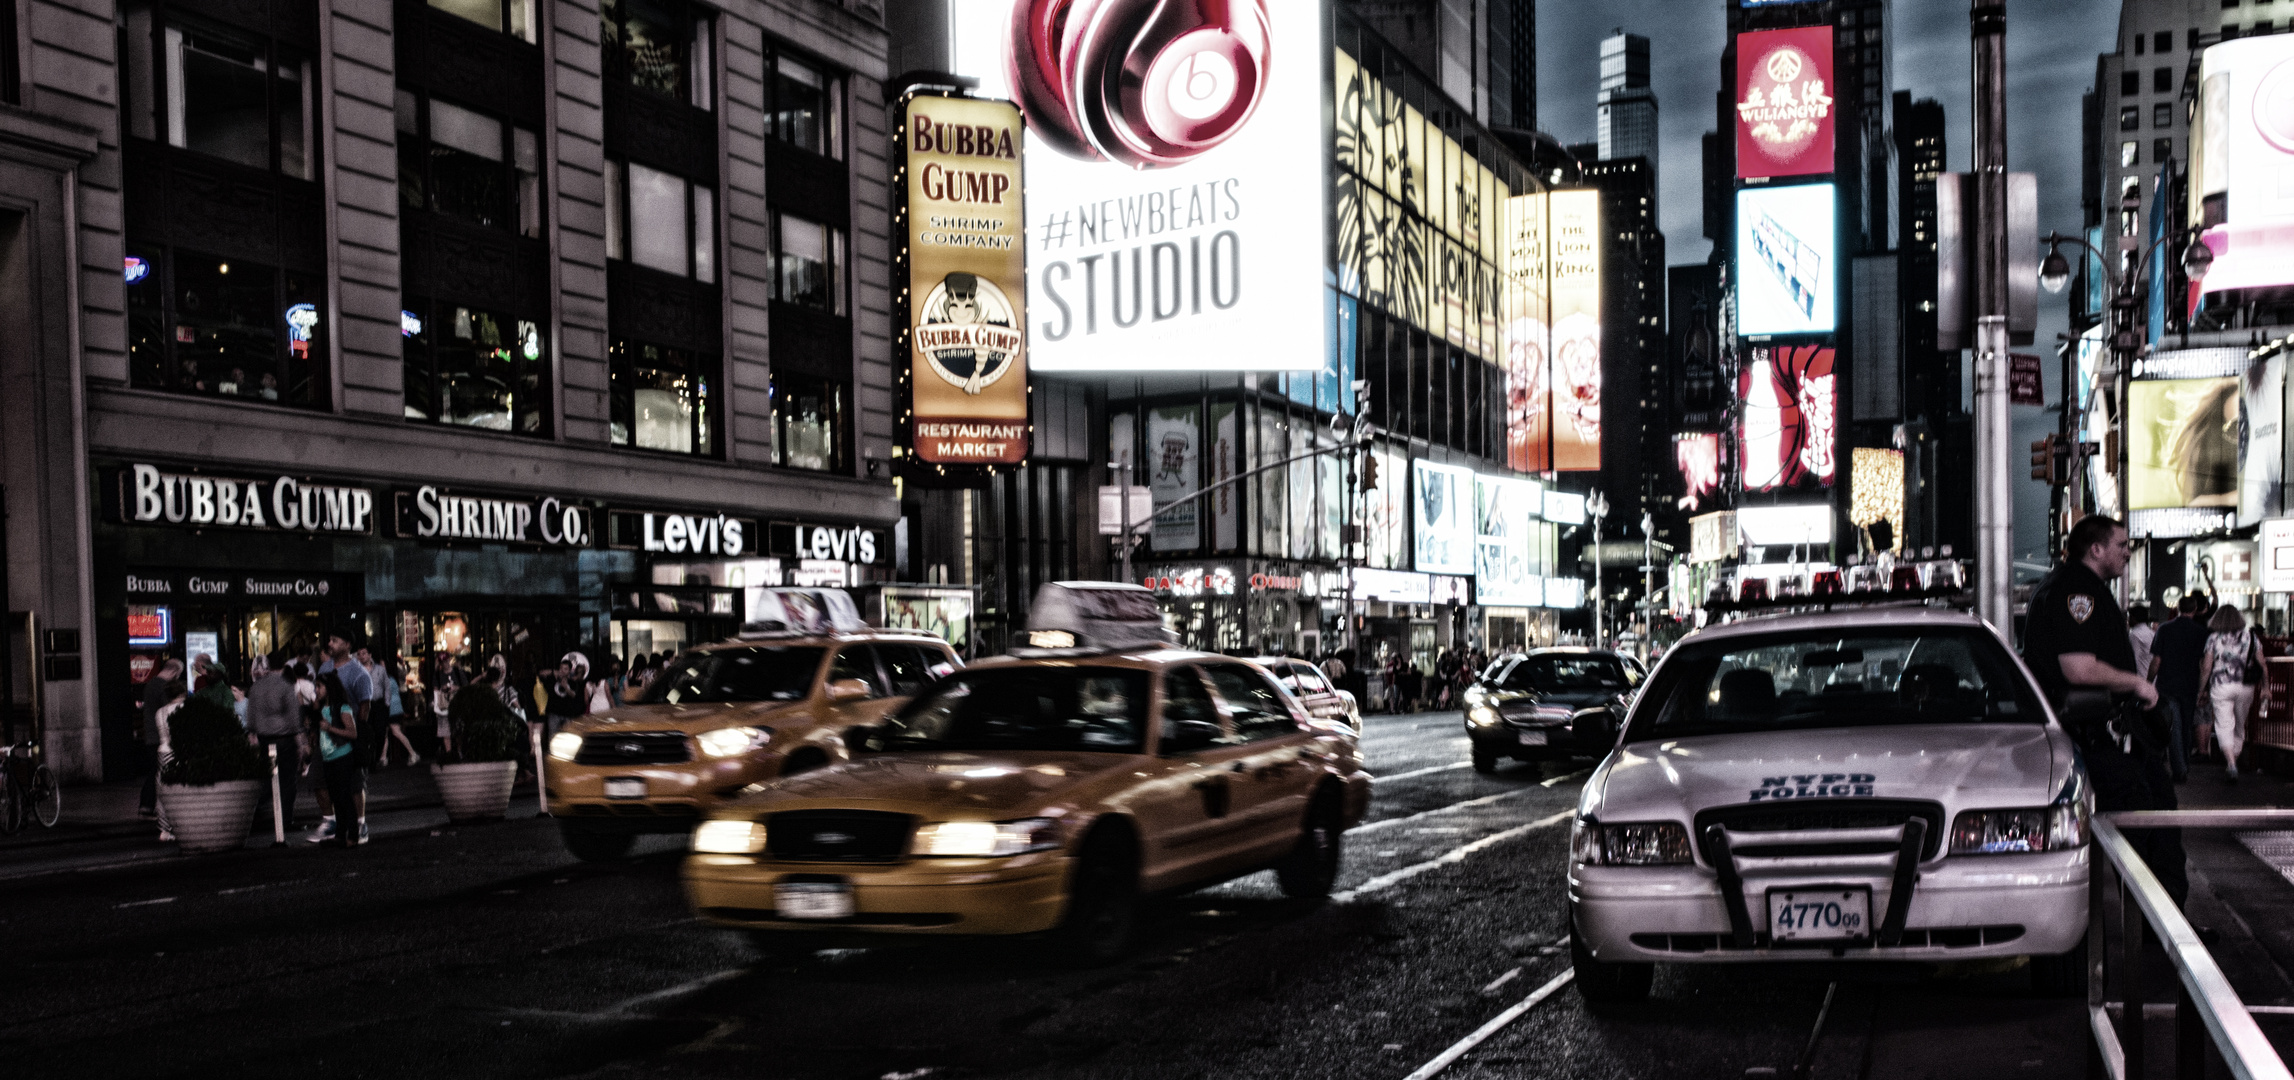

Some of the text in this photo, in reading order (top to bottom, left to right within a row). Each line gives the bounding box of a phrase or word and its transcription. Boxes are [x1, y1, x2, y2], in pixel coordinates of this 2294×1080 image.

[913, 112, 1017, 159] BUBBA
[921, 162, 1010, 205] GUMP
[1040, 177, 1241, 251] #NEWBEATS
[1455, 181, 1479, 231] THE
[929, 215, 1004, 232] SHRIMP
[1562, 227, 1585, 236] THE
[920, 231, 1014, 250] COMPANY
[1557, 240, 1591, 256] LION
[1432, 215, 1469, 307] LION
[1555, 261, 1594, 279] KING
[1041, 229, 1242, 342] STUDIO
[919, 327, 1019, 350] BUBBA GUMP
[937, 348, 974, 360] SHRIMP
[918, 423, 1025, 440] RESTAURANT
[938, 443, 1007, 458] MARKET
[133, 463, 372, 532] BUBBA GUMP
[417, 485, 589, 546] SHRIMP CO.
[127, 575, 172, 592] BUBBA
[189, 577, 229, 593] GUMP
[246, 578, 293, 595] SHRIMP
[1761, 773, 1876, 788] NYPD
[1750, 784, 1874, 801] POLICE
[1778, 902, 1842, 929] 4770
